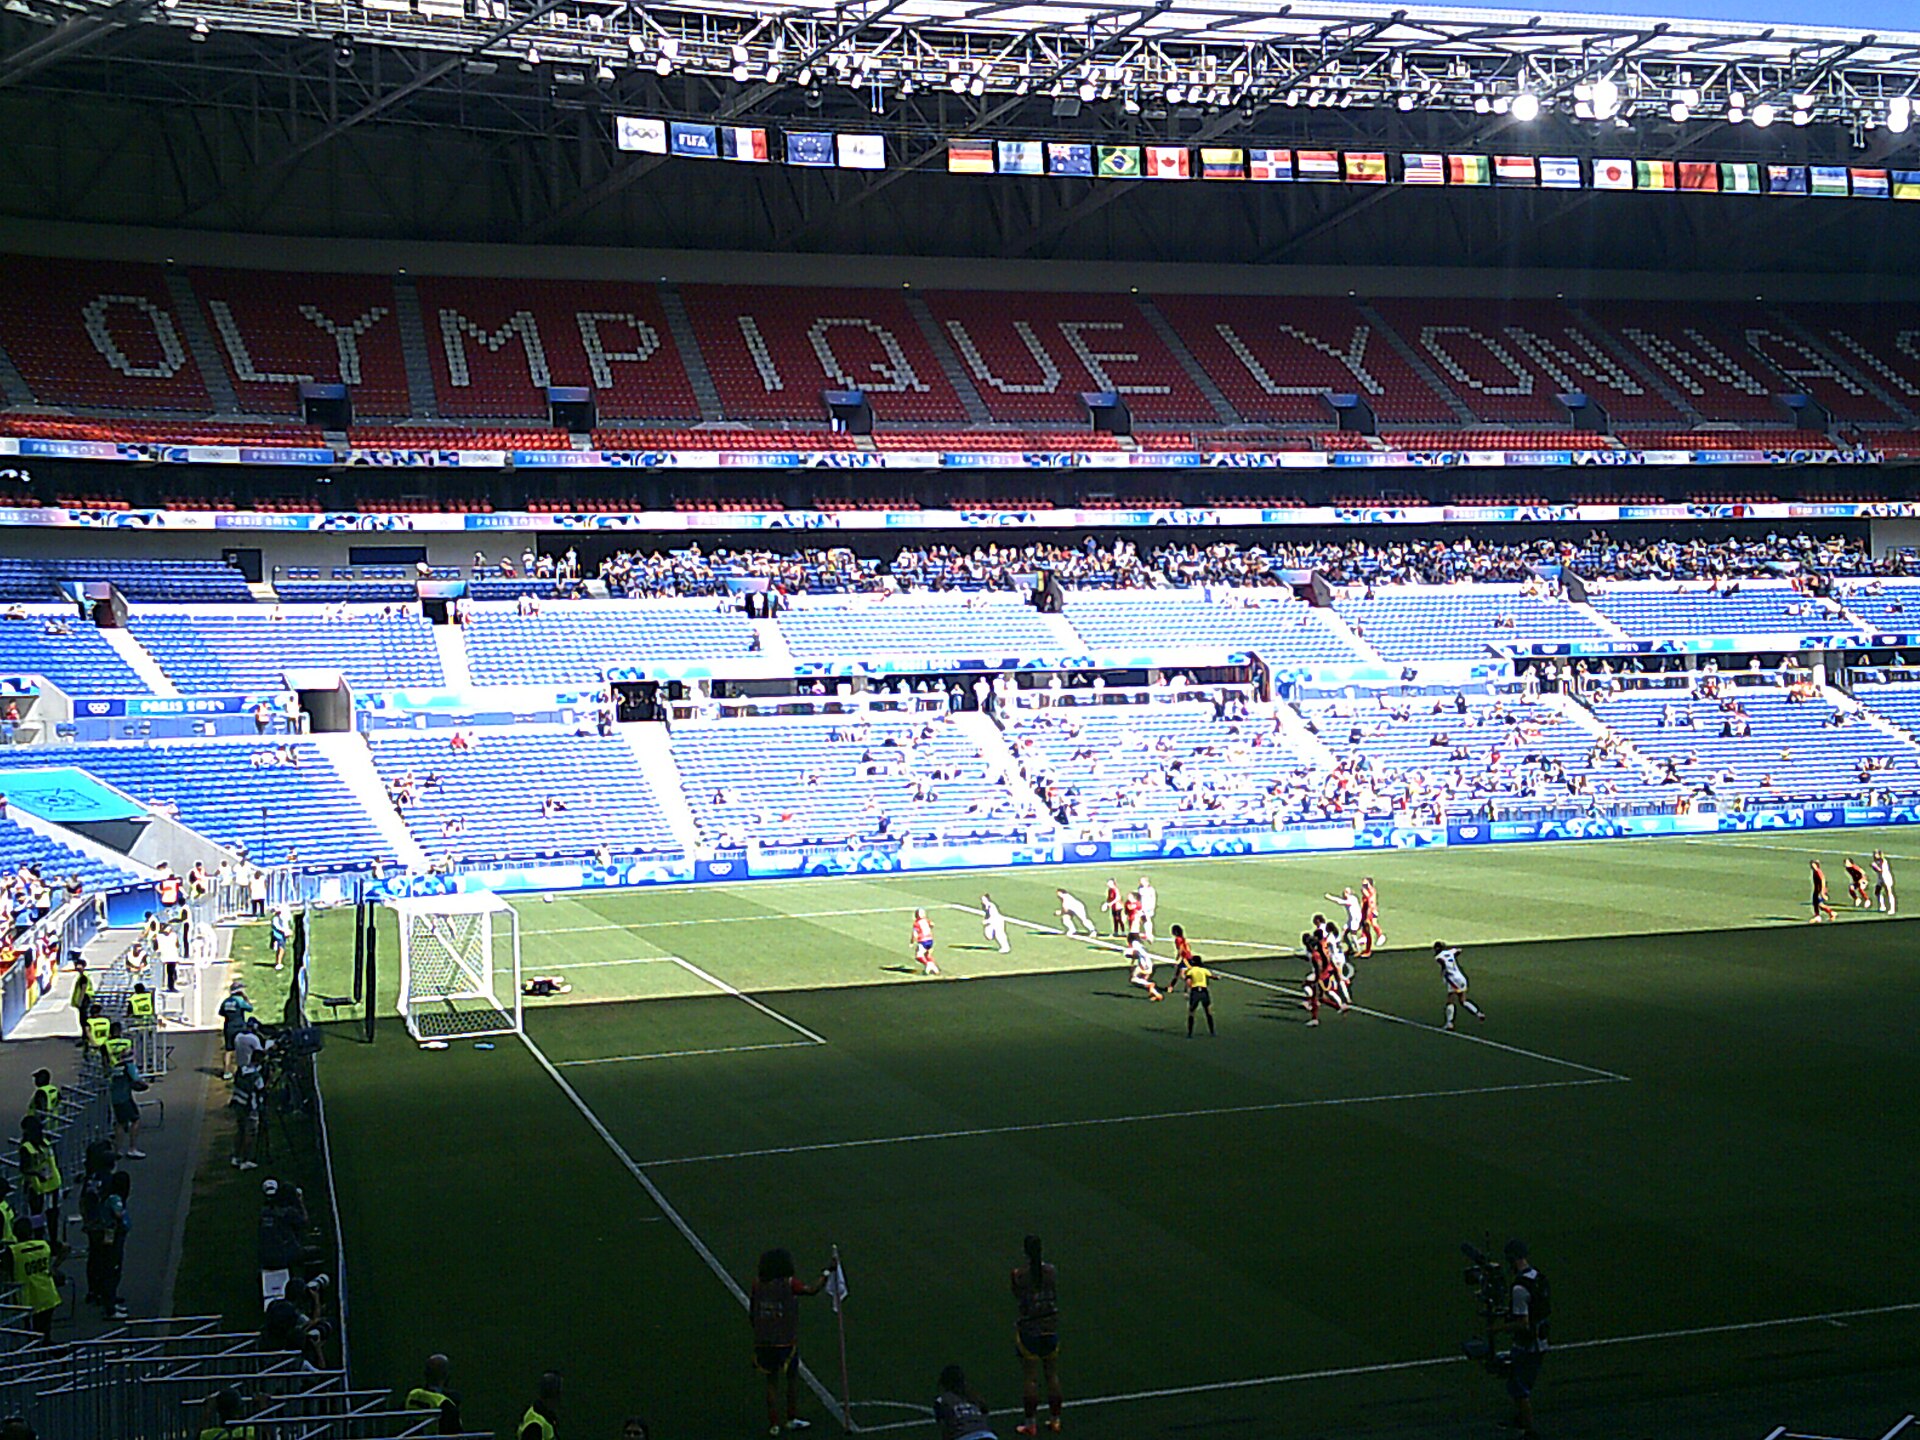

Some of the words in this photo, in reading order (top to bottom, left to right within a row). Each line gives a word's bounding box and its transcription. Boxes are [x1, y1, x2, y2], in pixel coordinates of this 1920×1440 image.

[678, 134, 708, 147] FIFA
[81, 294, 1172, 397] OLYMPIQUE
[252, 452, 287, 461] PARIS
[226, 516, 262, 526] PARIS
[140, 700, 184, 713] PARIS
[186, 699, 225, 712] 2024
